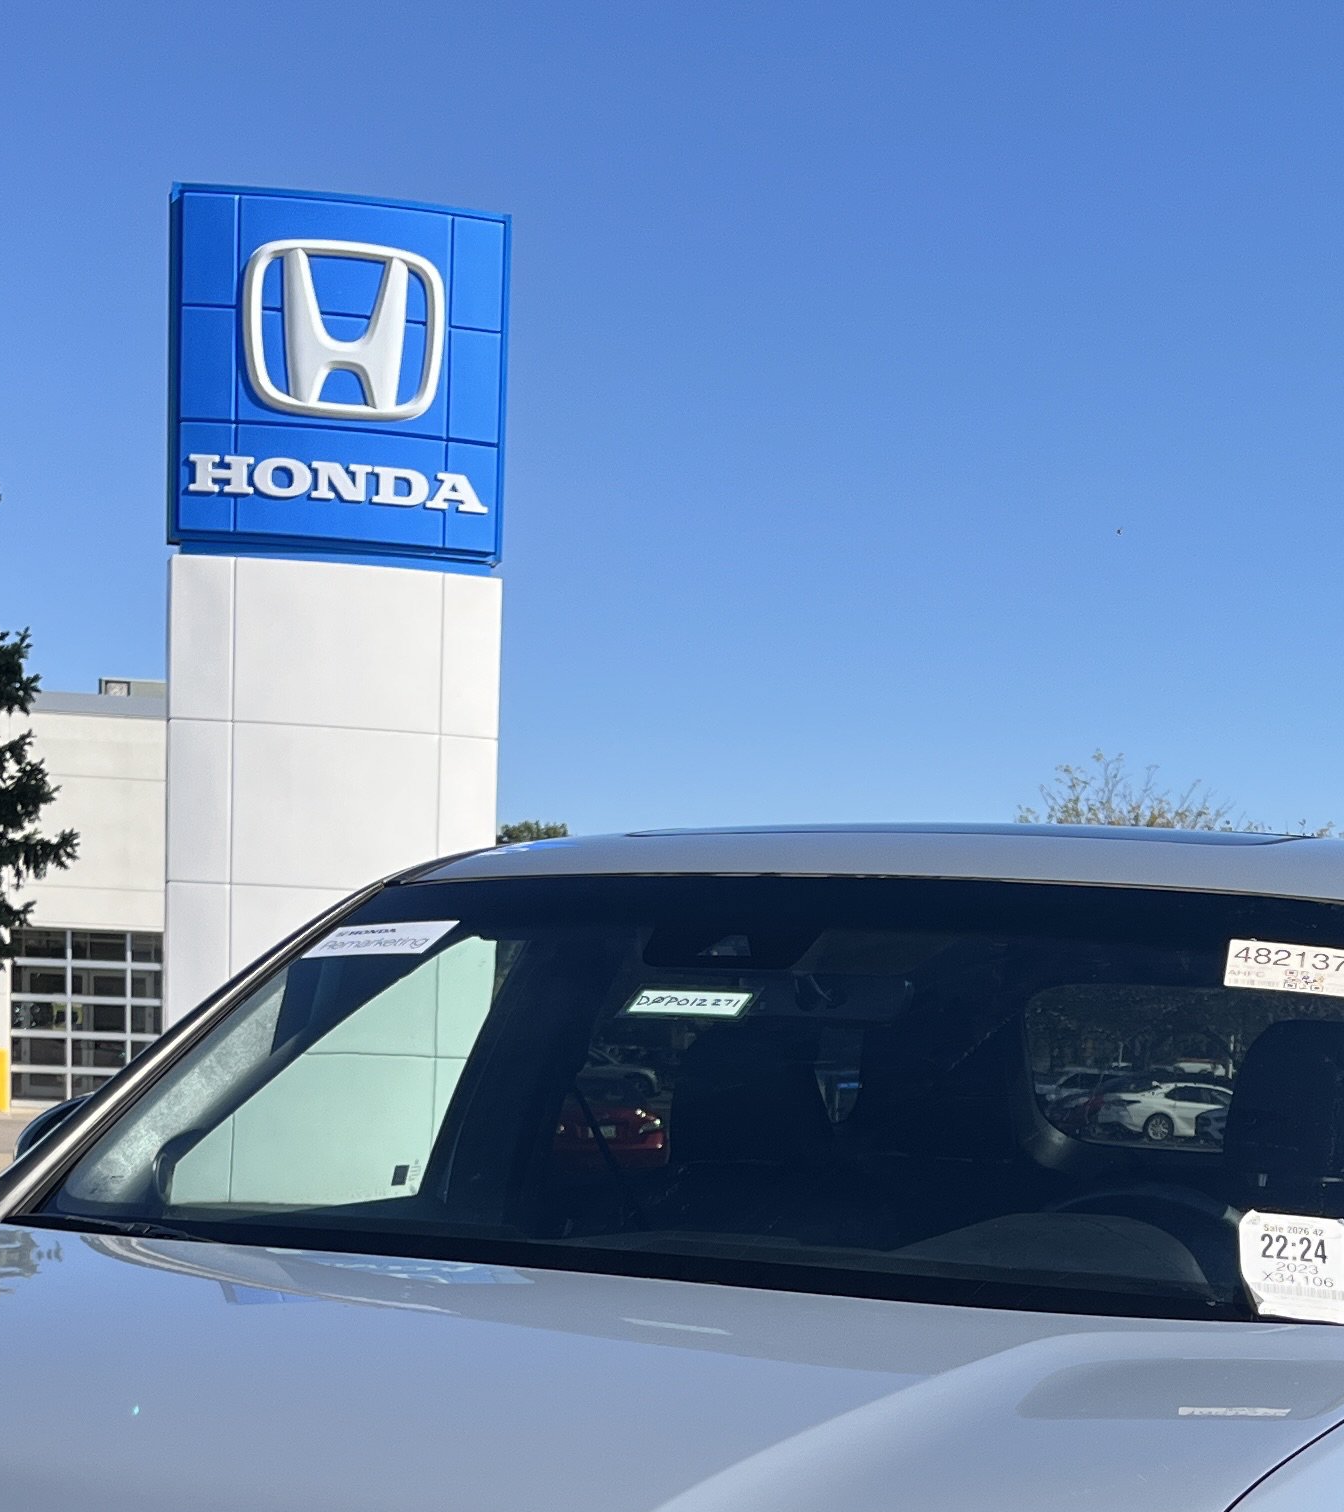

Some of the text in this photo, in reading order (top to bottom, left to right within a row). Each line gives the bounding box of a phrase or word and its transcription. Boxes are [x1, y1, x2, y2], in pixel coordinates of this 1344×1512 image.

[187, 453, 489, 515] HONDA
[318, 936, 430, 951] Remarketing
[1260, 1233, 1328, 1264] 22:24
[1276, 1262, 1319, 1275] 2023
[1303, 1275, 1334, 1288] 106
